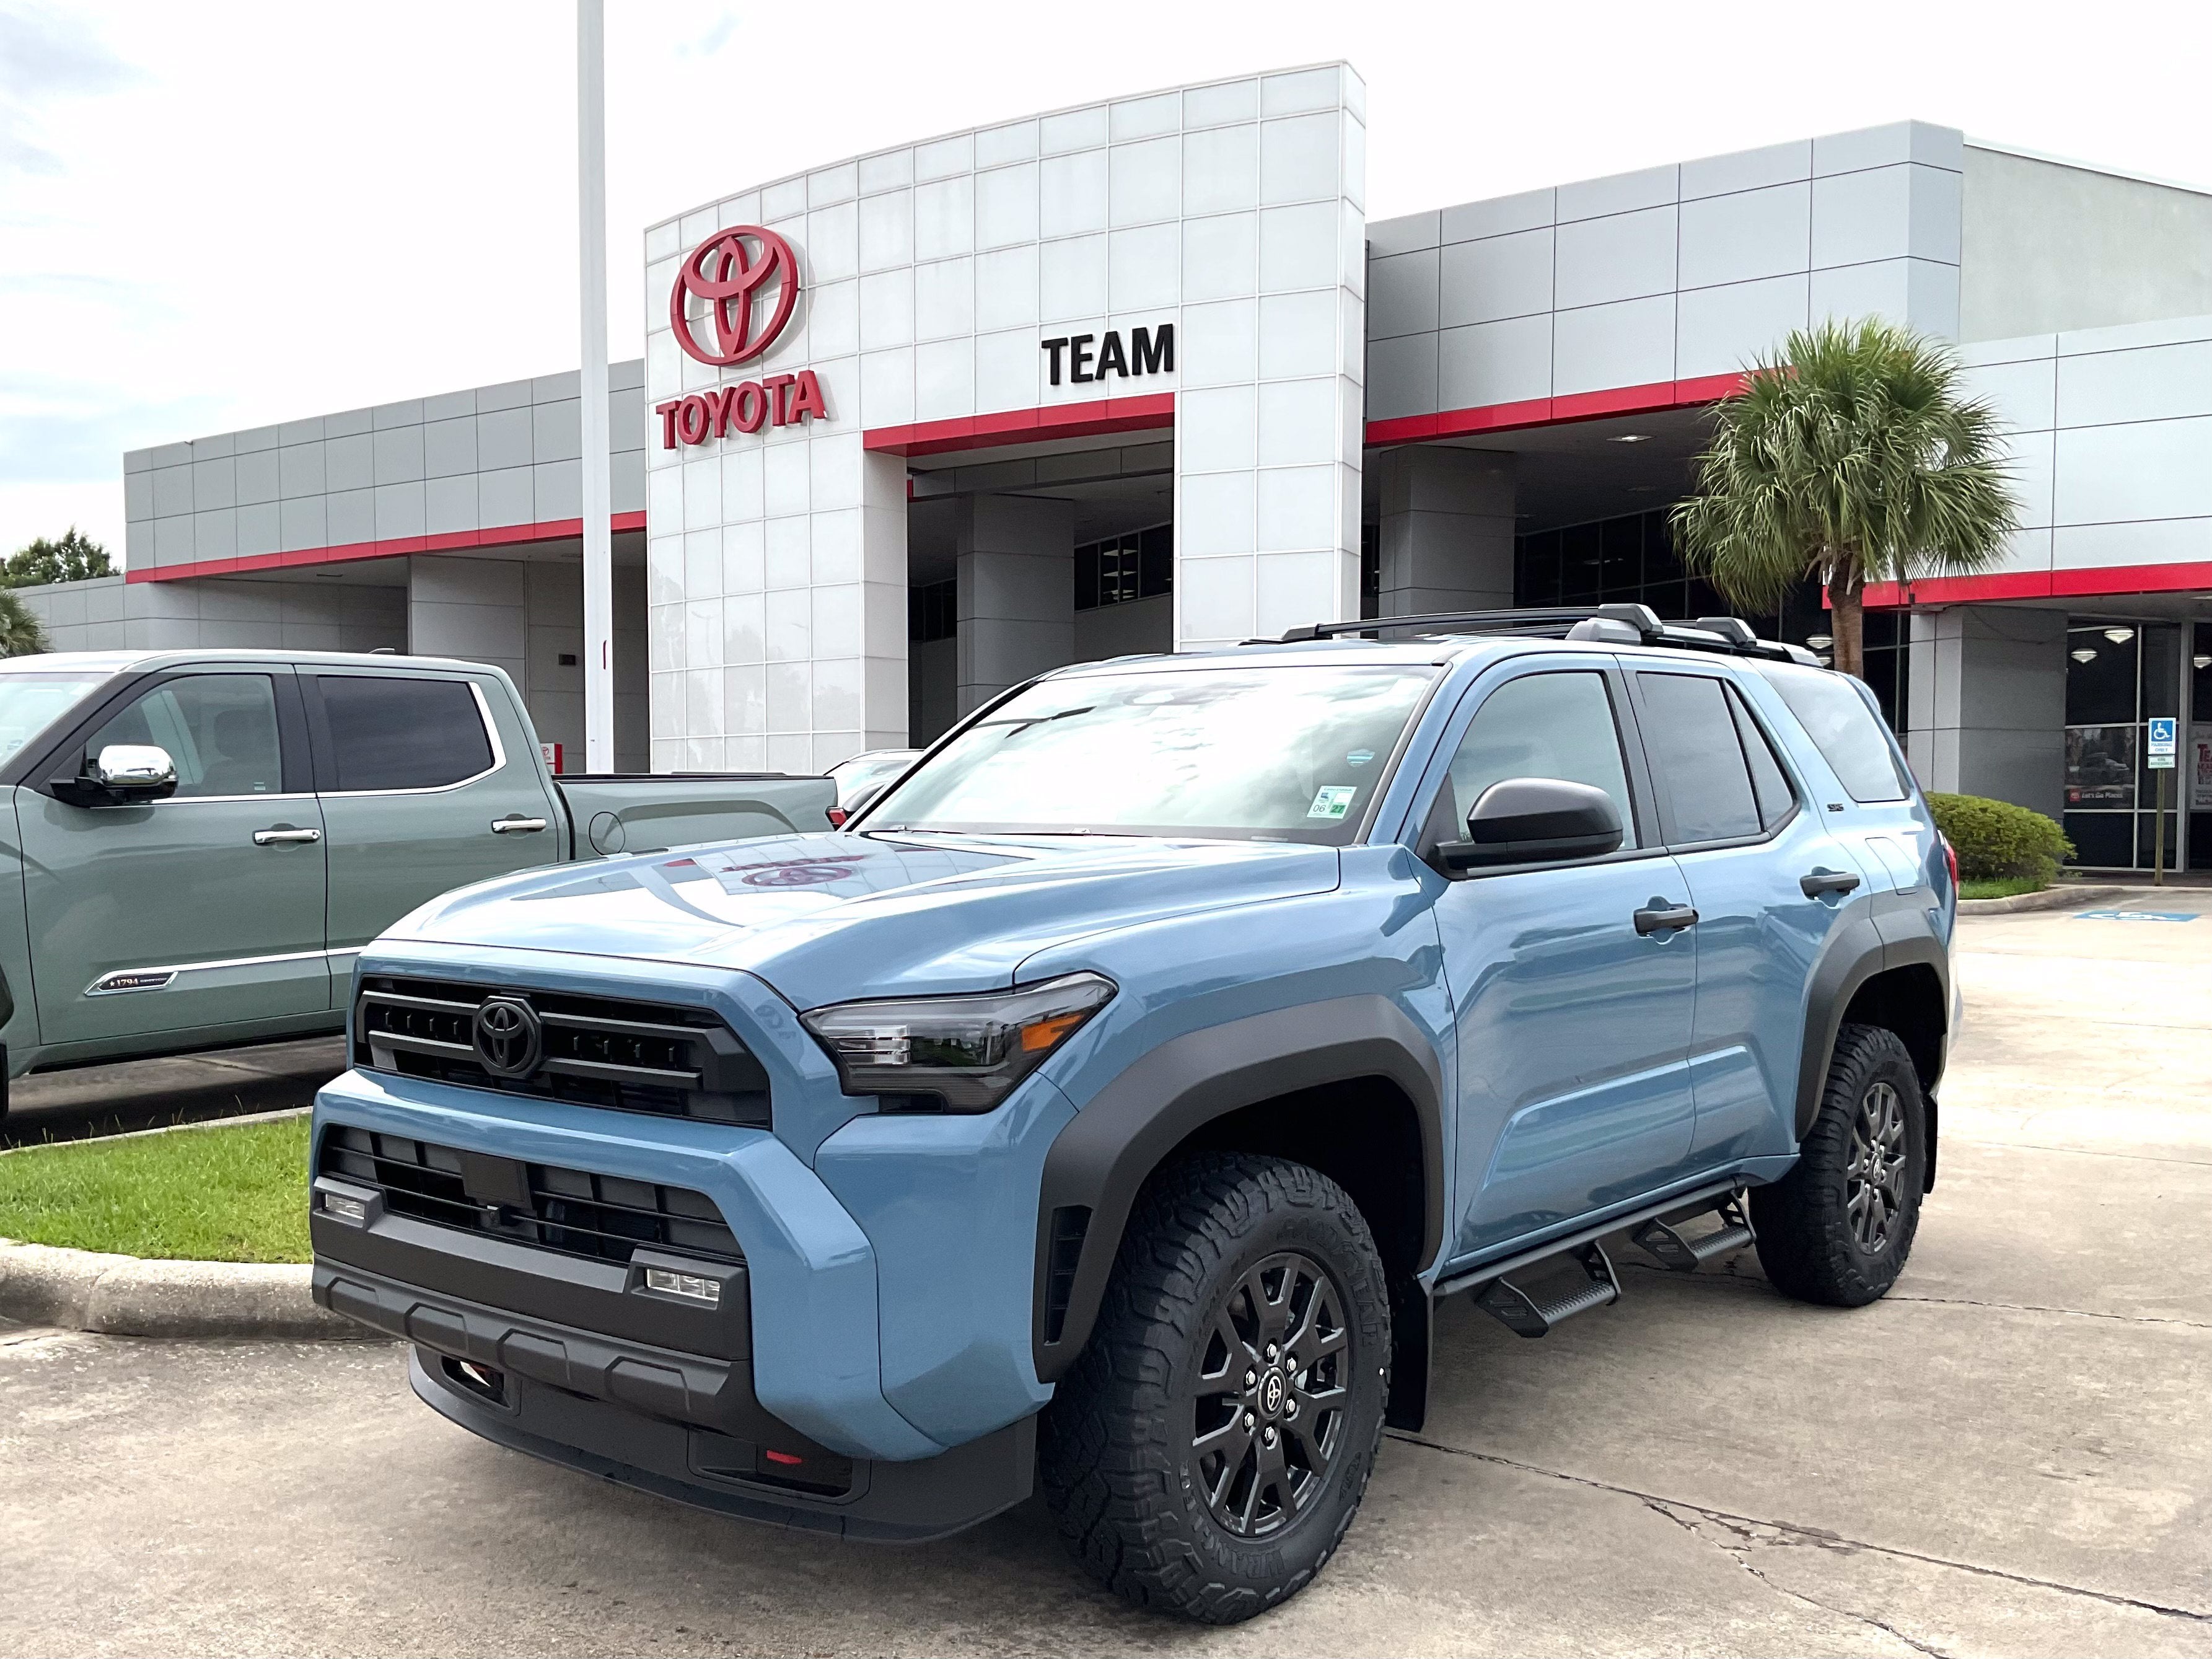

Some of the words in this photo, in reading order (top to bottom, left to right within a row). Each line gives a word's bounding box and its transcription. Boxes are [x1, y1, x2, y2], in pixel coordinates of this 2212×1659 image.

[1042, 323, 1173, 385] TEAM
[656, 370, 827, 449] TOYOTA
[1331, 805, 1346, 813] 27
[116, 978, 138, 987] 1794
